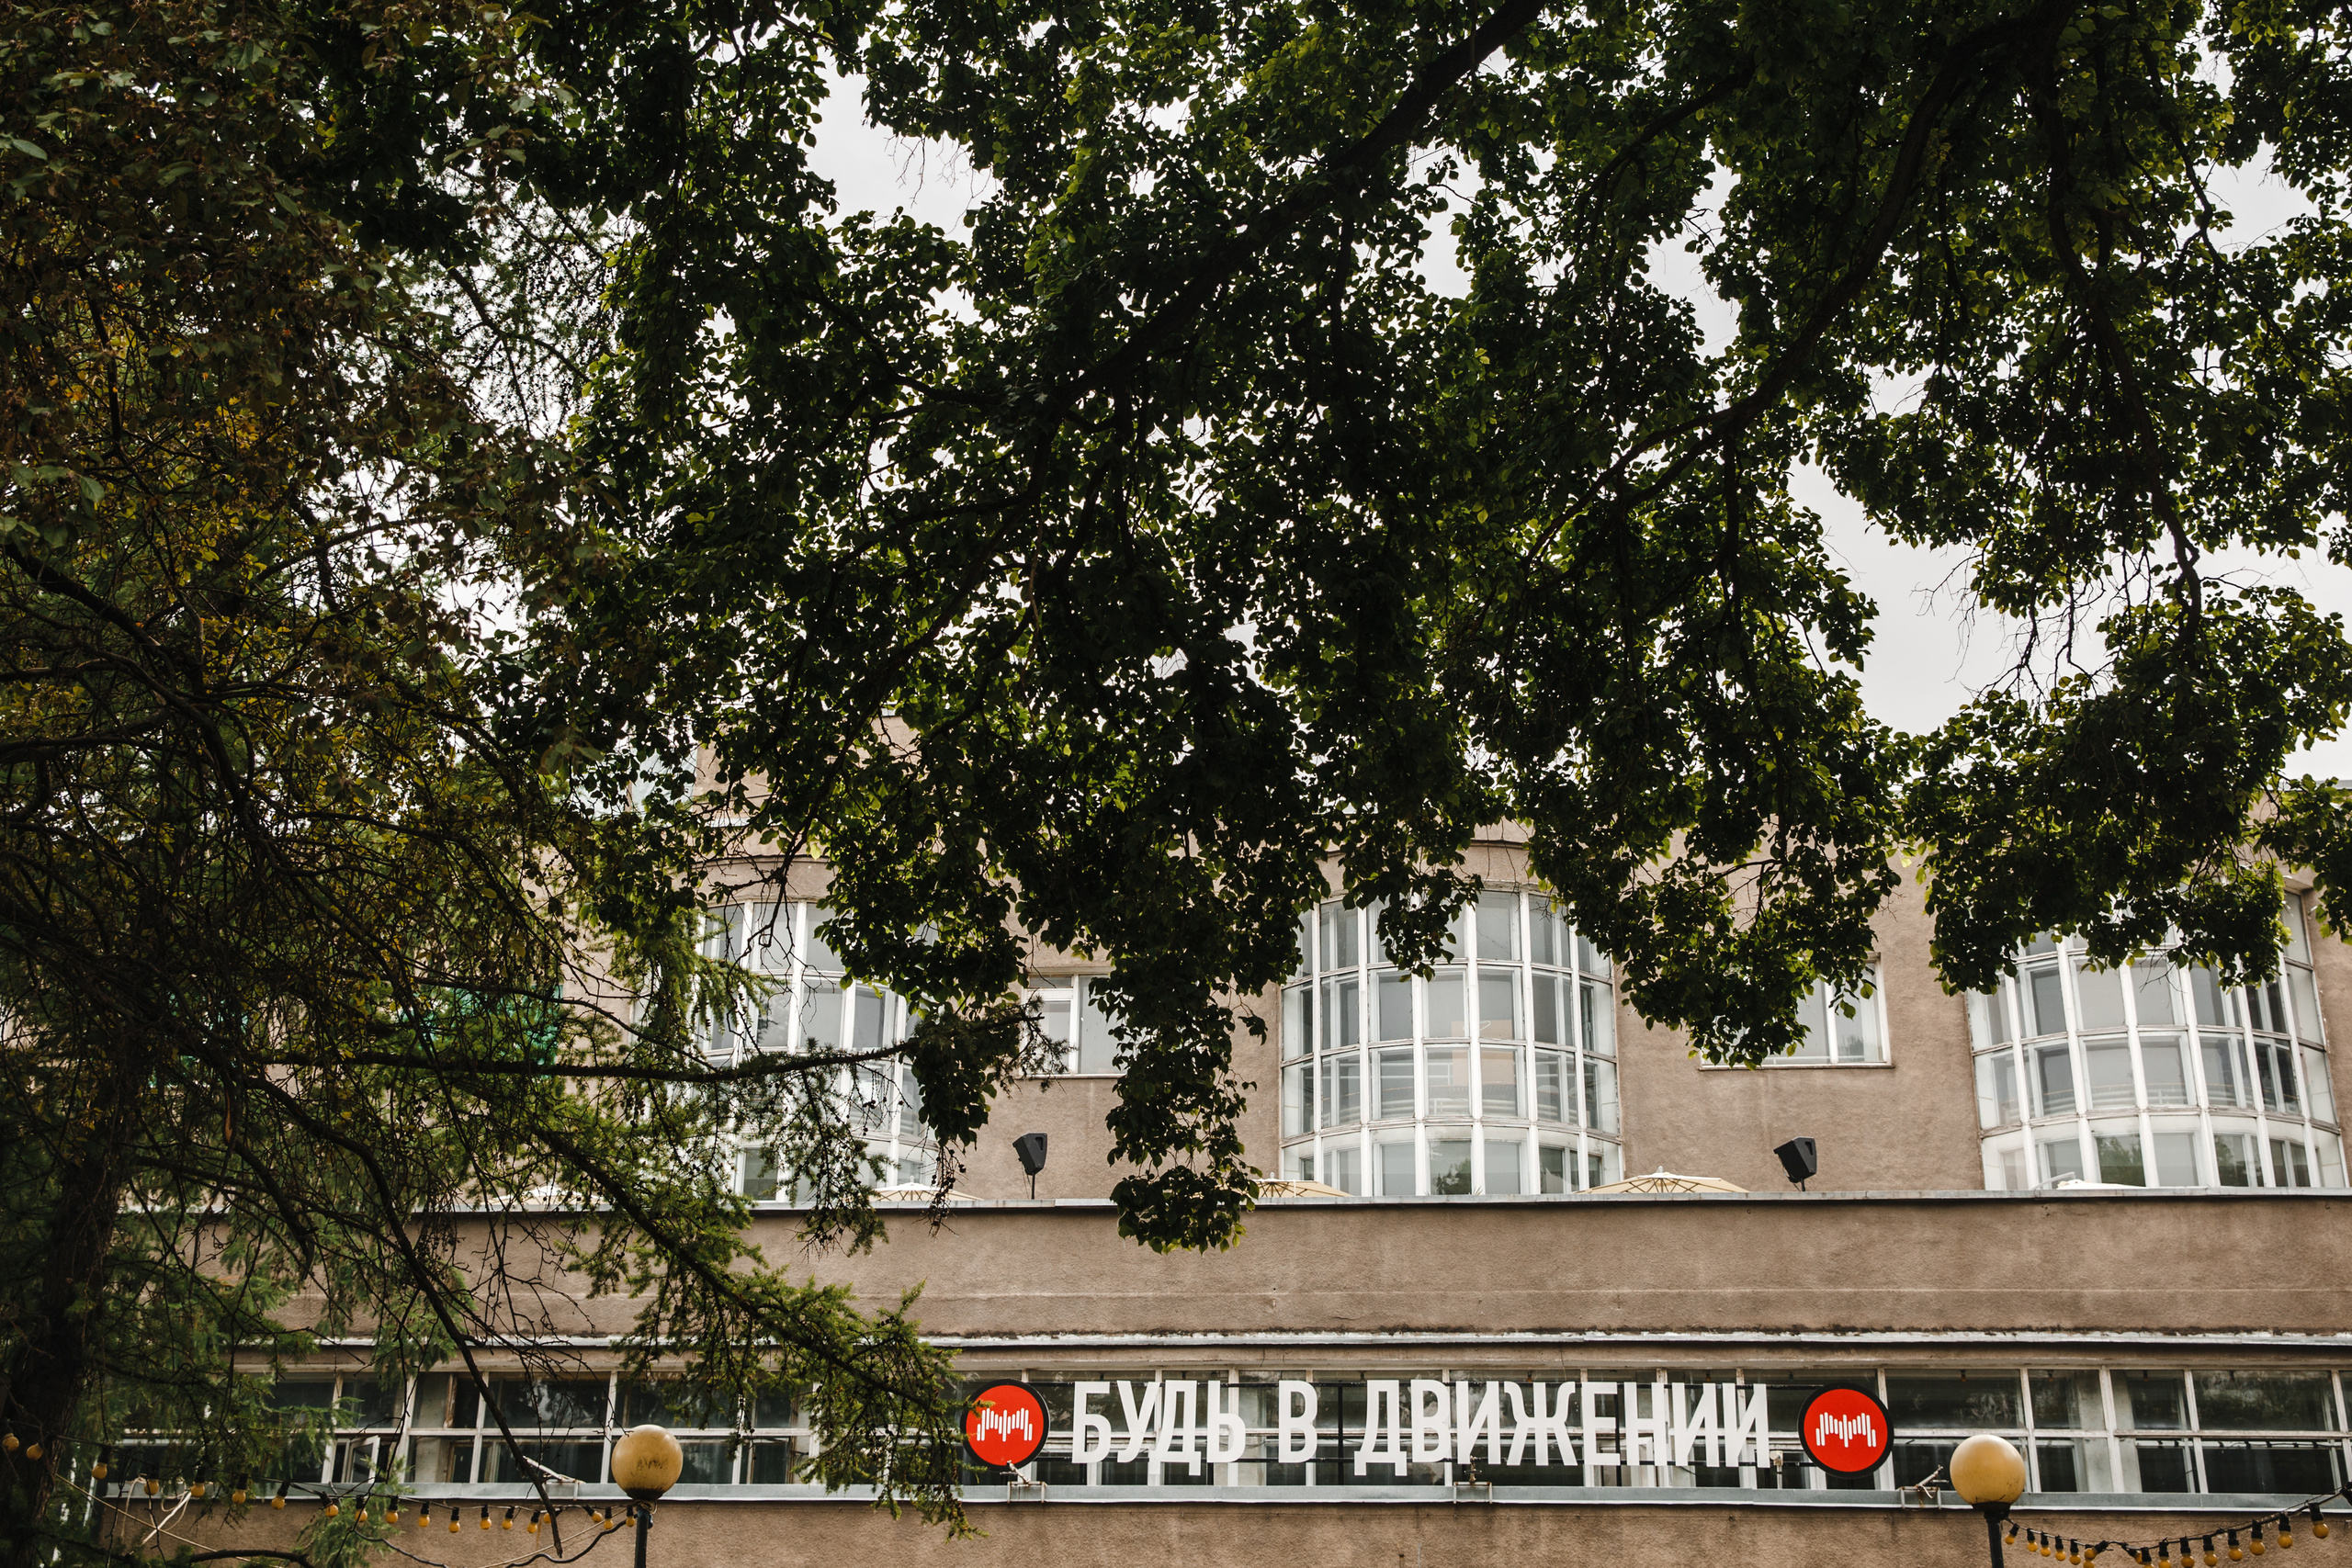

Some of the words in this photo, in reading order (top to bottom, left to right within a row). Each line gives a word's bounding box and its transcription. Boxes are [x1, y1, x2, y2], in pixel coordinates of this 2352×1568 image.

[1071, 1380, 1247, 1476] БУДЬ
[1278, 1380, 1318, 1463] В
[1354, 1380, 1770, 1476] ДВИЖЕНИИ
